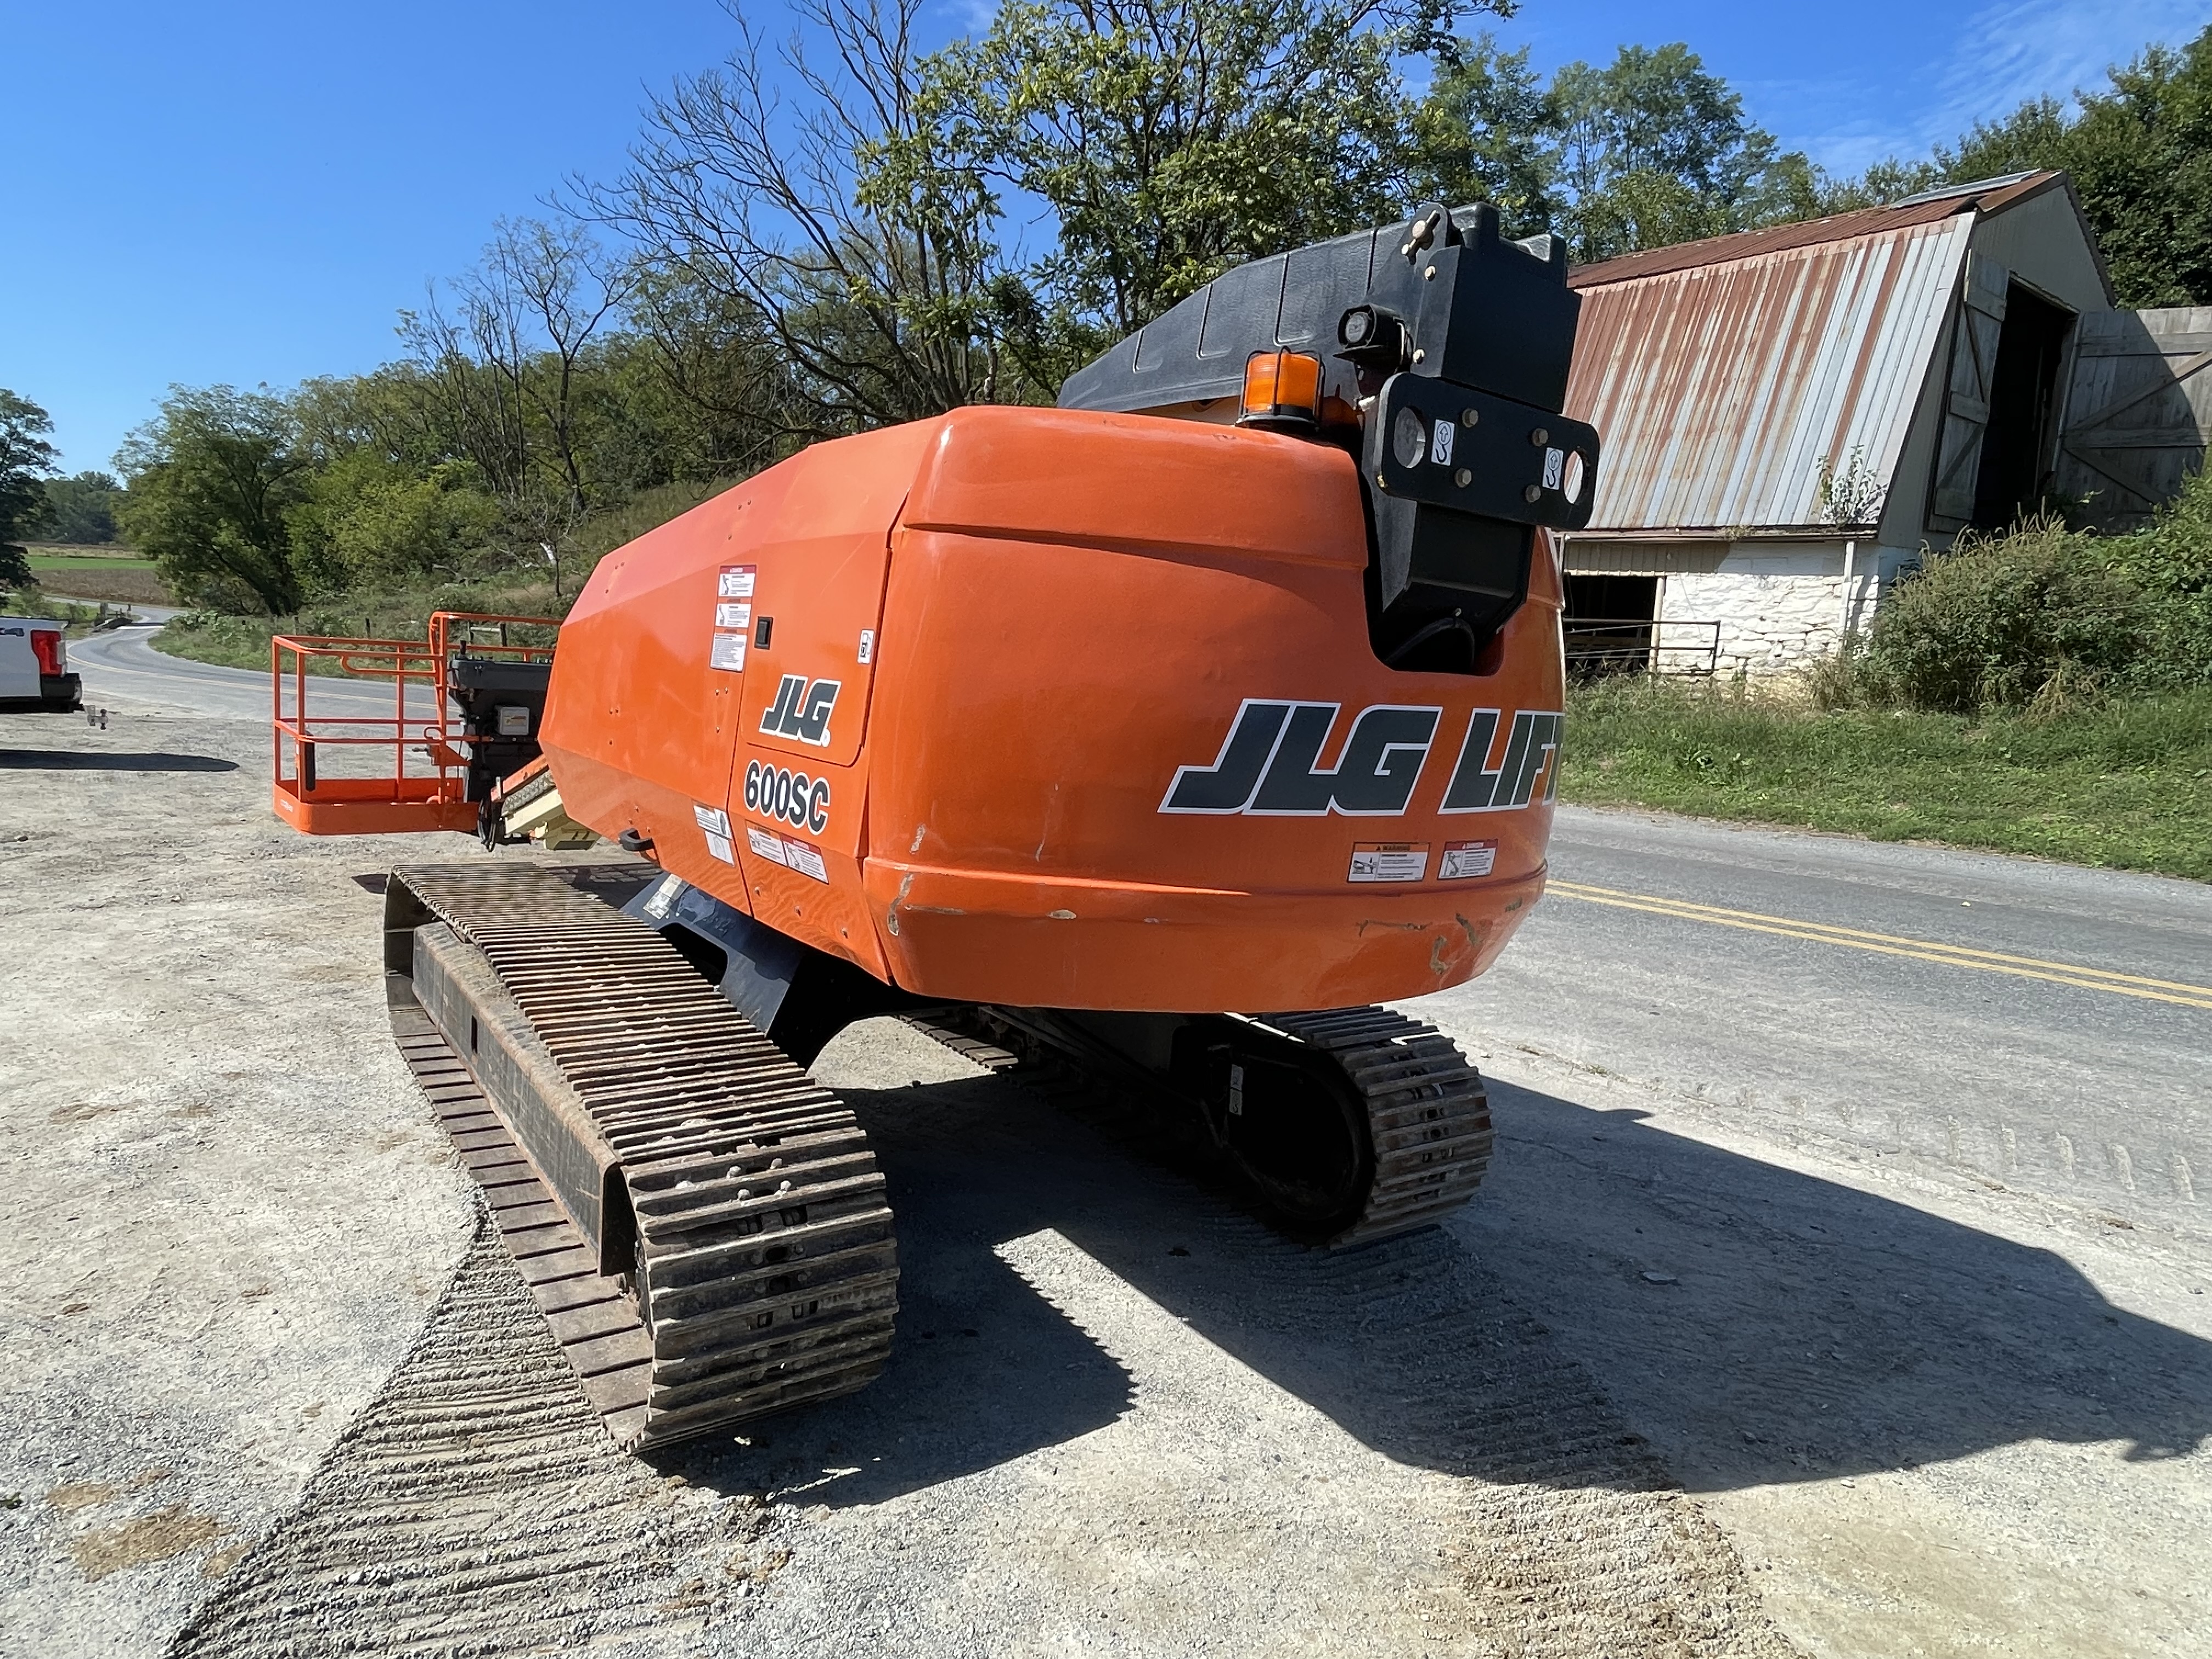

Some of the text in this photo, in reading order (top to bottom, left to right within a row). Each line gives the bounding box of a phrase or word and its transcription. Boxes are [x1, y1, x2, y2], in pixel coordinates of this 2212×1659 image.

[759, 675, 842, 747] JLG
[1158, 699, 1443, 815] JLG
[744, 760, 831, 834] 600SC
